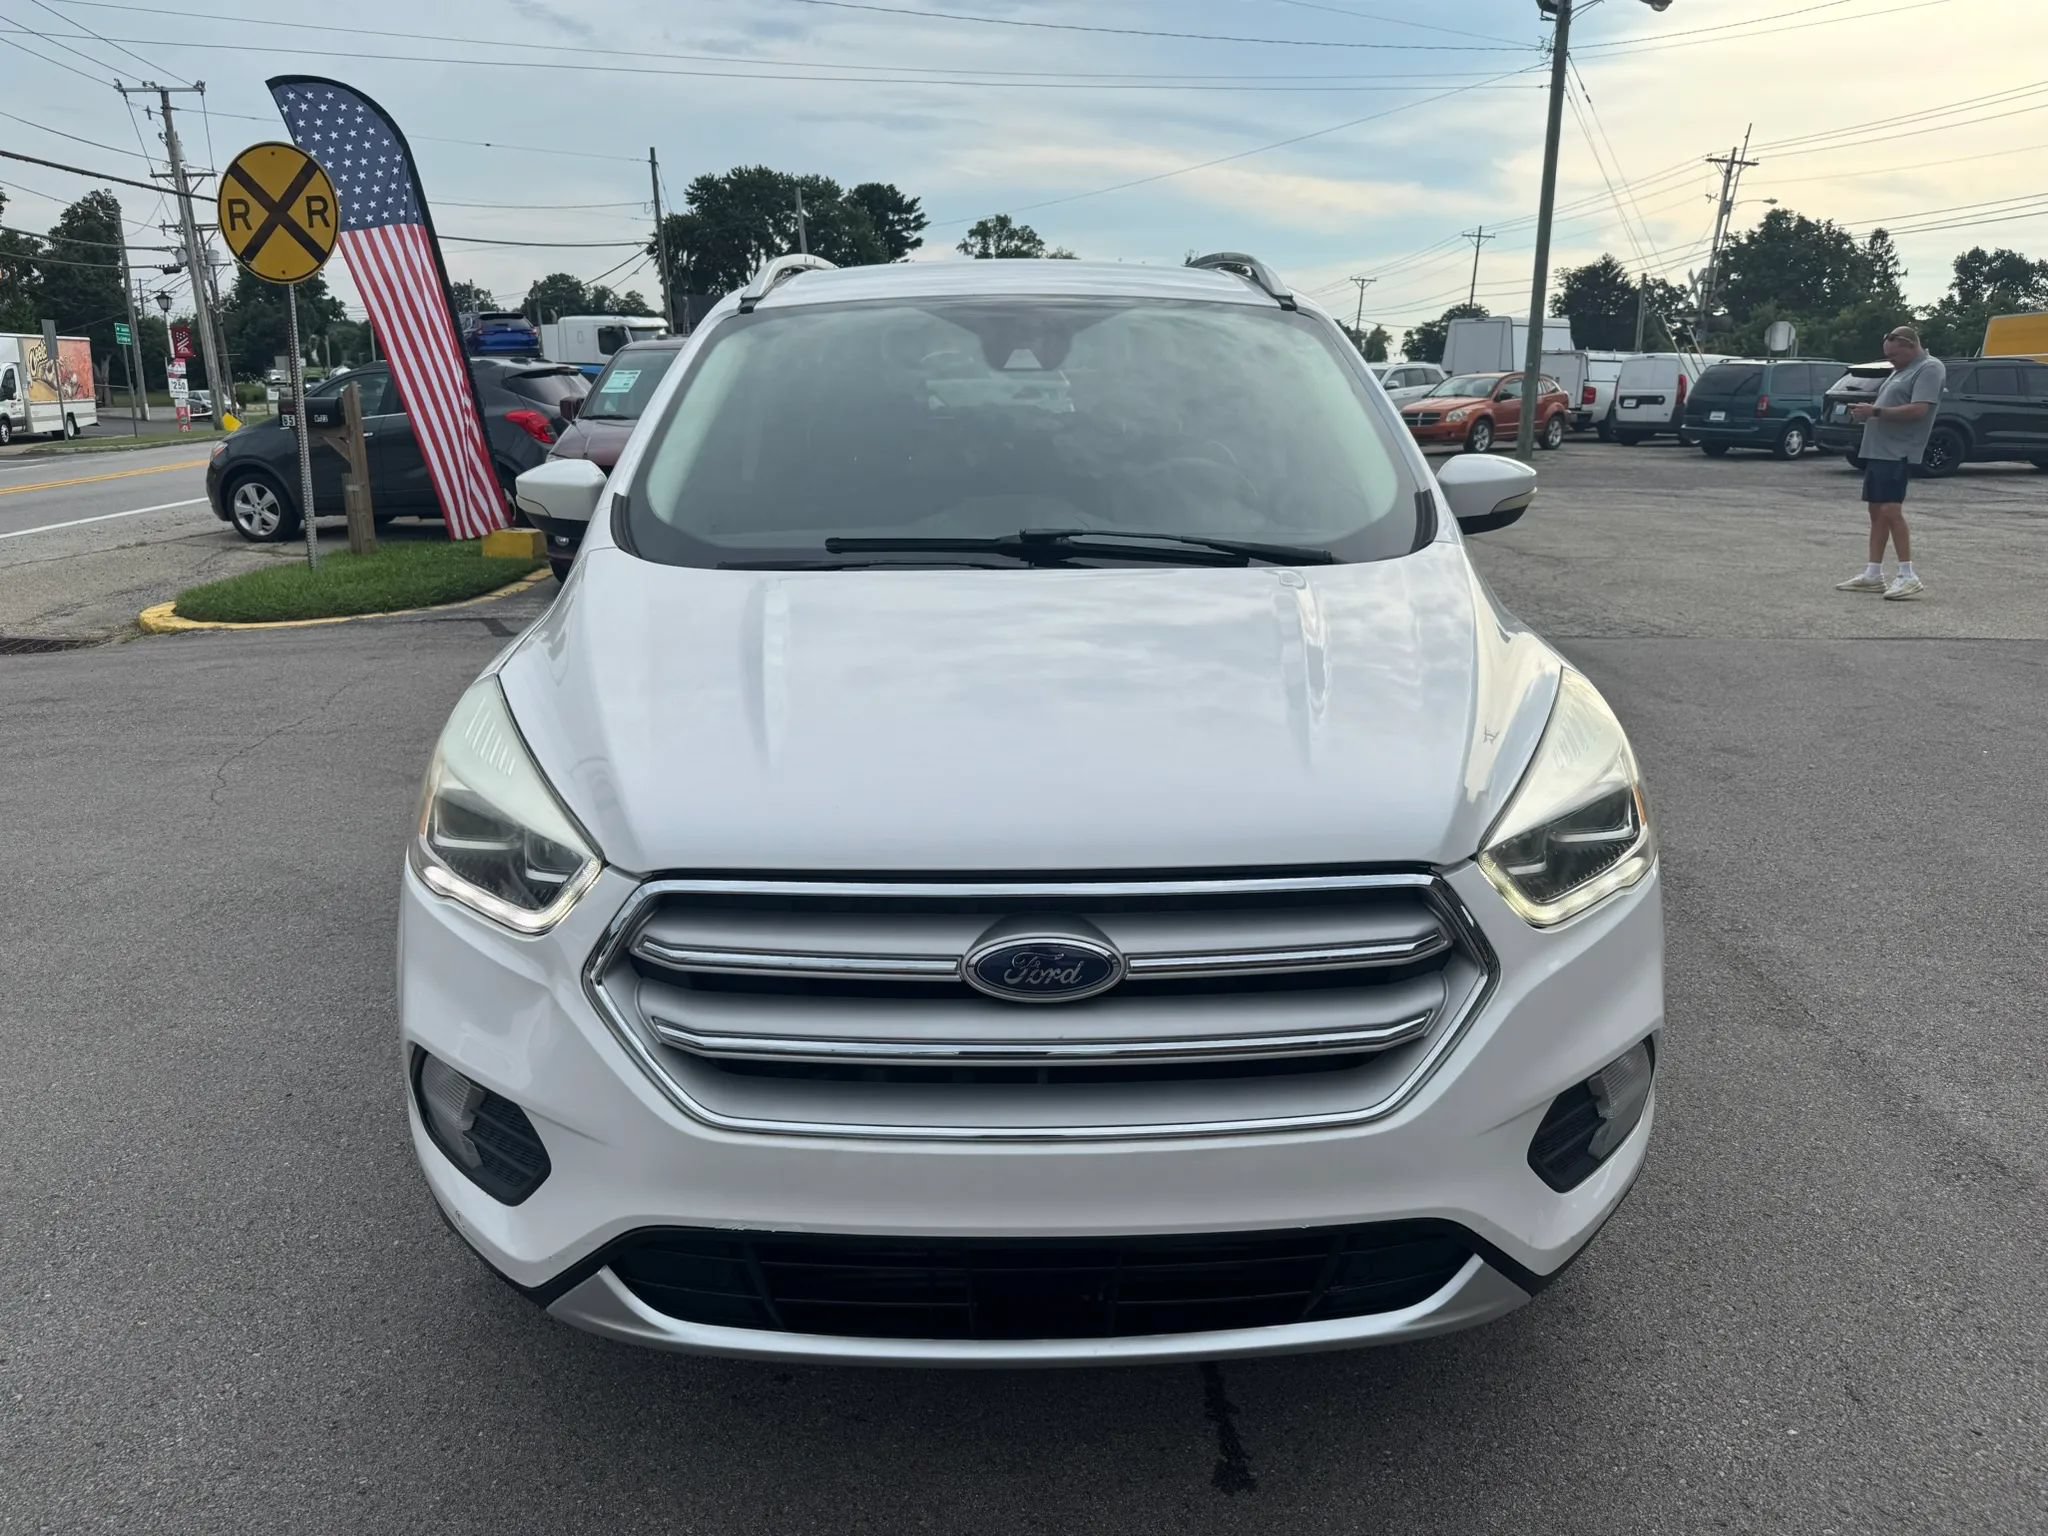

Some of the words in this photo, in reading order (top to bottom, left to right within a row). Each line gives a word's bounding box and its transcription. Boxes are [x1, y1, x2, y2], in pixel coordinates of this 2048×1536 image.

[227, 198, 252, 231] R
[305, 195, 331, 228] R
[1004, 952, 1085, 985] Ford
